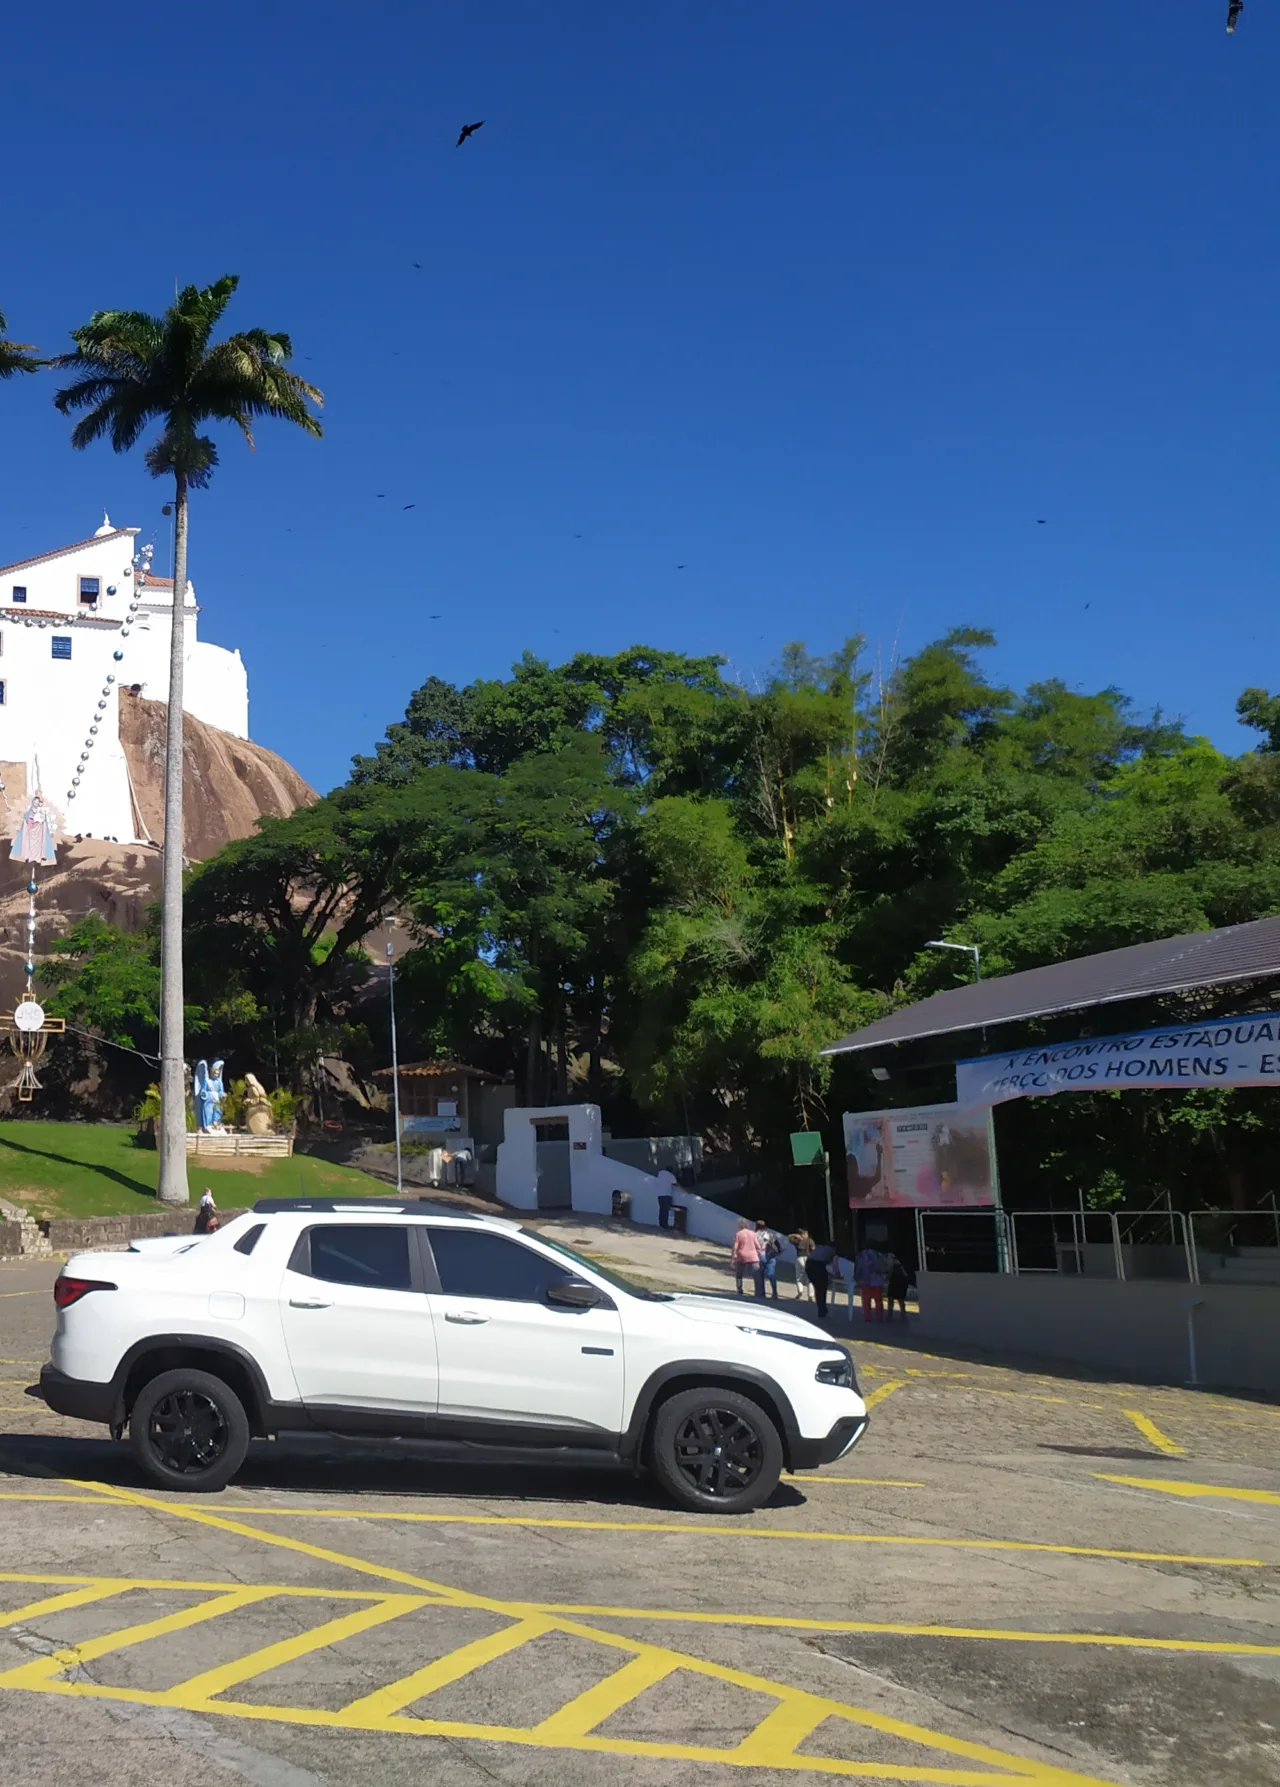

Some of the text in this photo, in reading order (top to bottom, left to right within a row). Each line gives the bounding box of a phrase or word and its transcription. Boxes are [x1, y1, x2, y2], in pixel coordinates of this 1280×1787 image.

[1004, 1057, 1020, 1071] X
[1022, 1037, 1145, 1067] ENCONTRO
[1056, 1062, 1099, 1083] DOS
[1104, 1056, 1229, 1077] HOMENS
